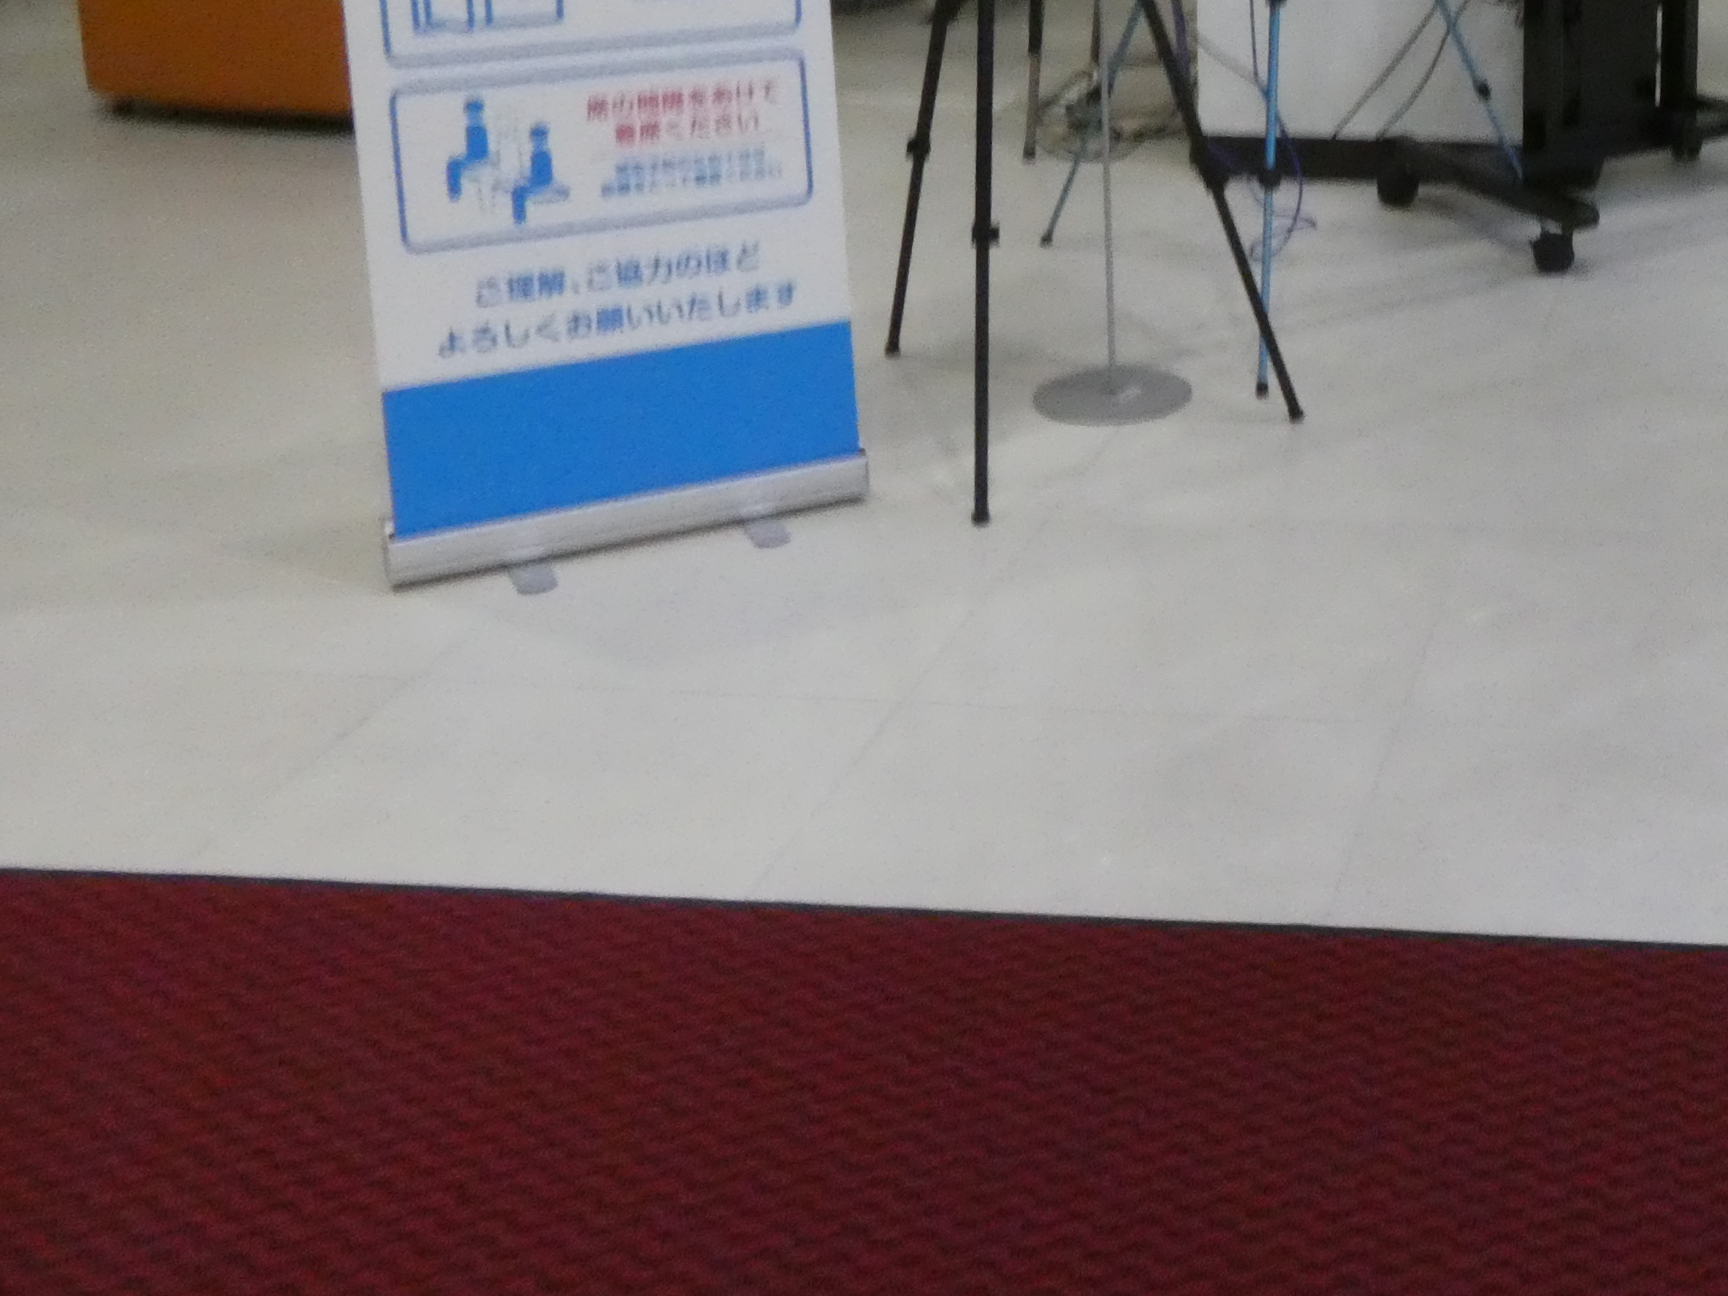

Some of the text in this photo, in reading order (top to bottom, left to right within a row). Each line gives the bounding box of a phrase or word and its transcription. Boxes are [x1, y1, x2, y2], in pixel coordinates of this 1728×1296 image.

[475, 241, 761, 308] ご理解、ご協力のほど
[438, 281, 796, 360] よろしくお願いいたします
